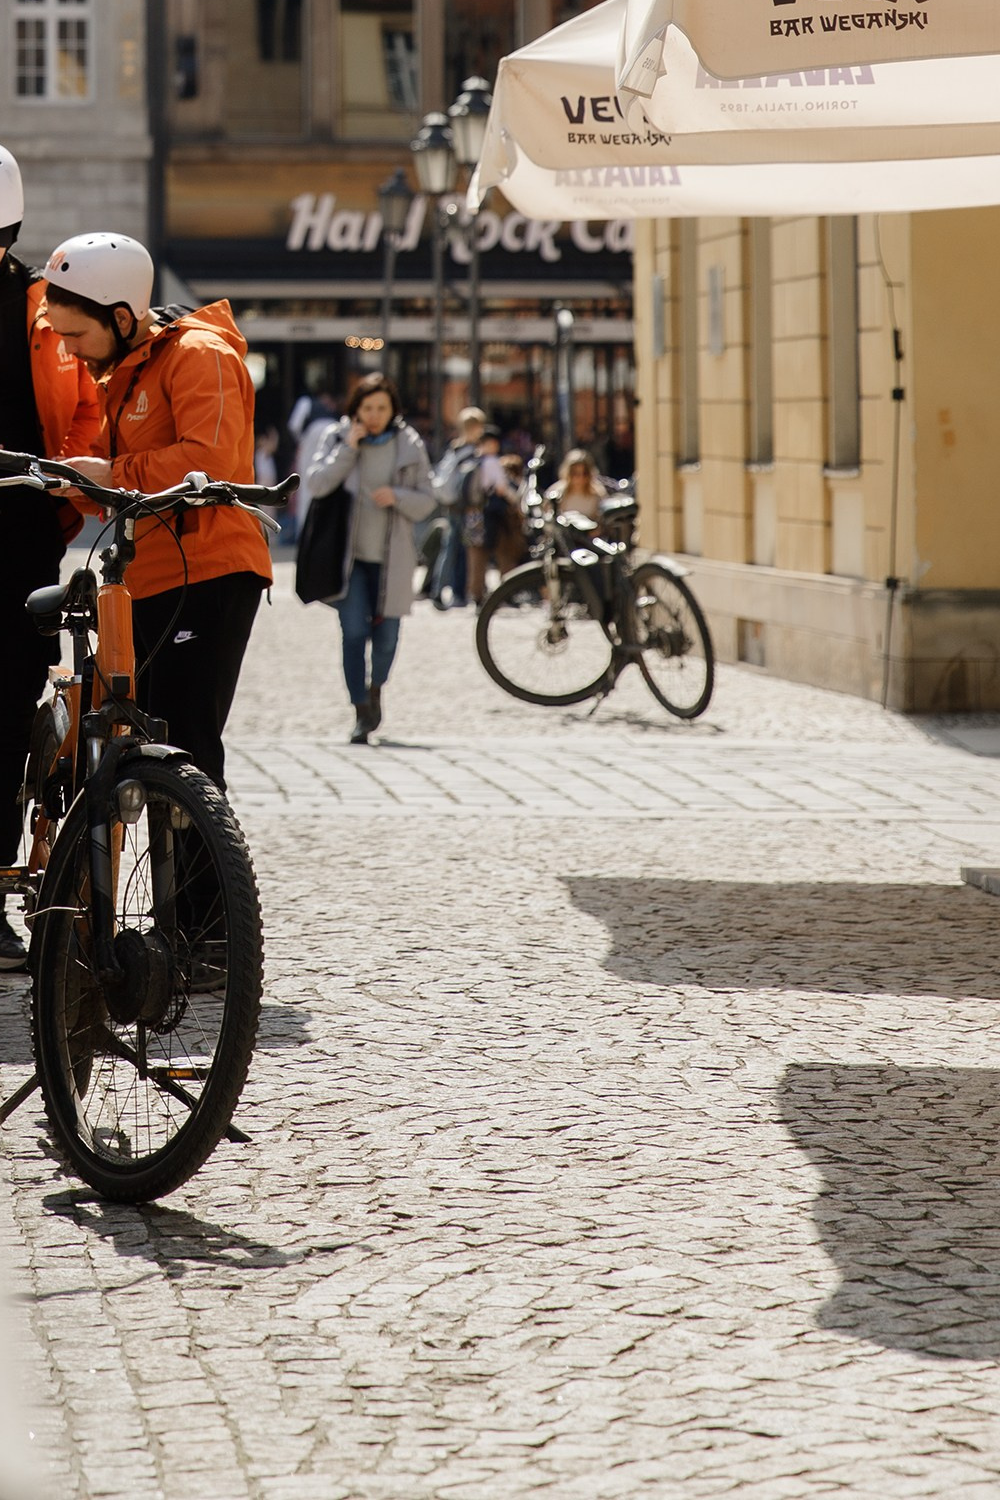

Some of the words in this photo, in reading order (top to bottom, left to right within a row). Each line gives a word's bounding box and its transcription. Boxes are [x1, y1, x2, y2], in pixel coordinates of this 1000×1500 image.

[770, 16, 815, 37] BAR
[819, 9, 929, 33] WEGAŃSKI
[560, 95, 650, 124] VE
[567, 132, 597, 144] BAR
